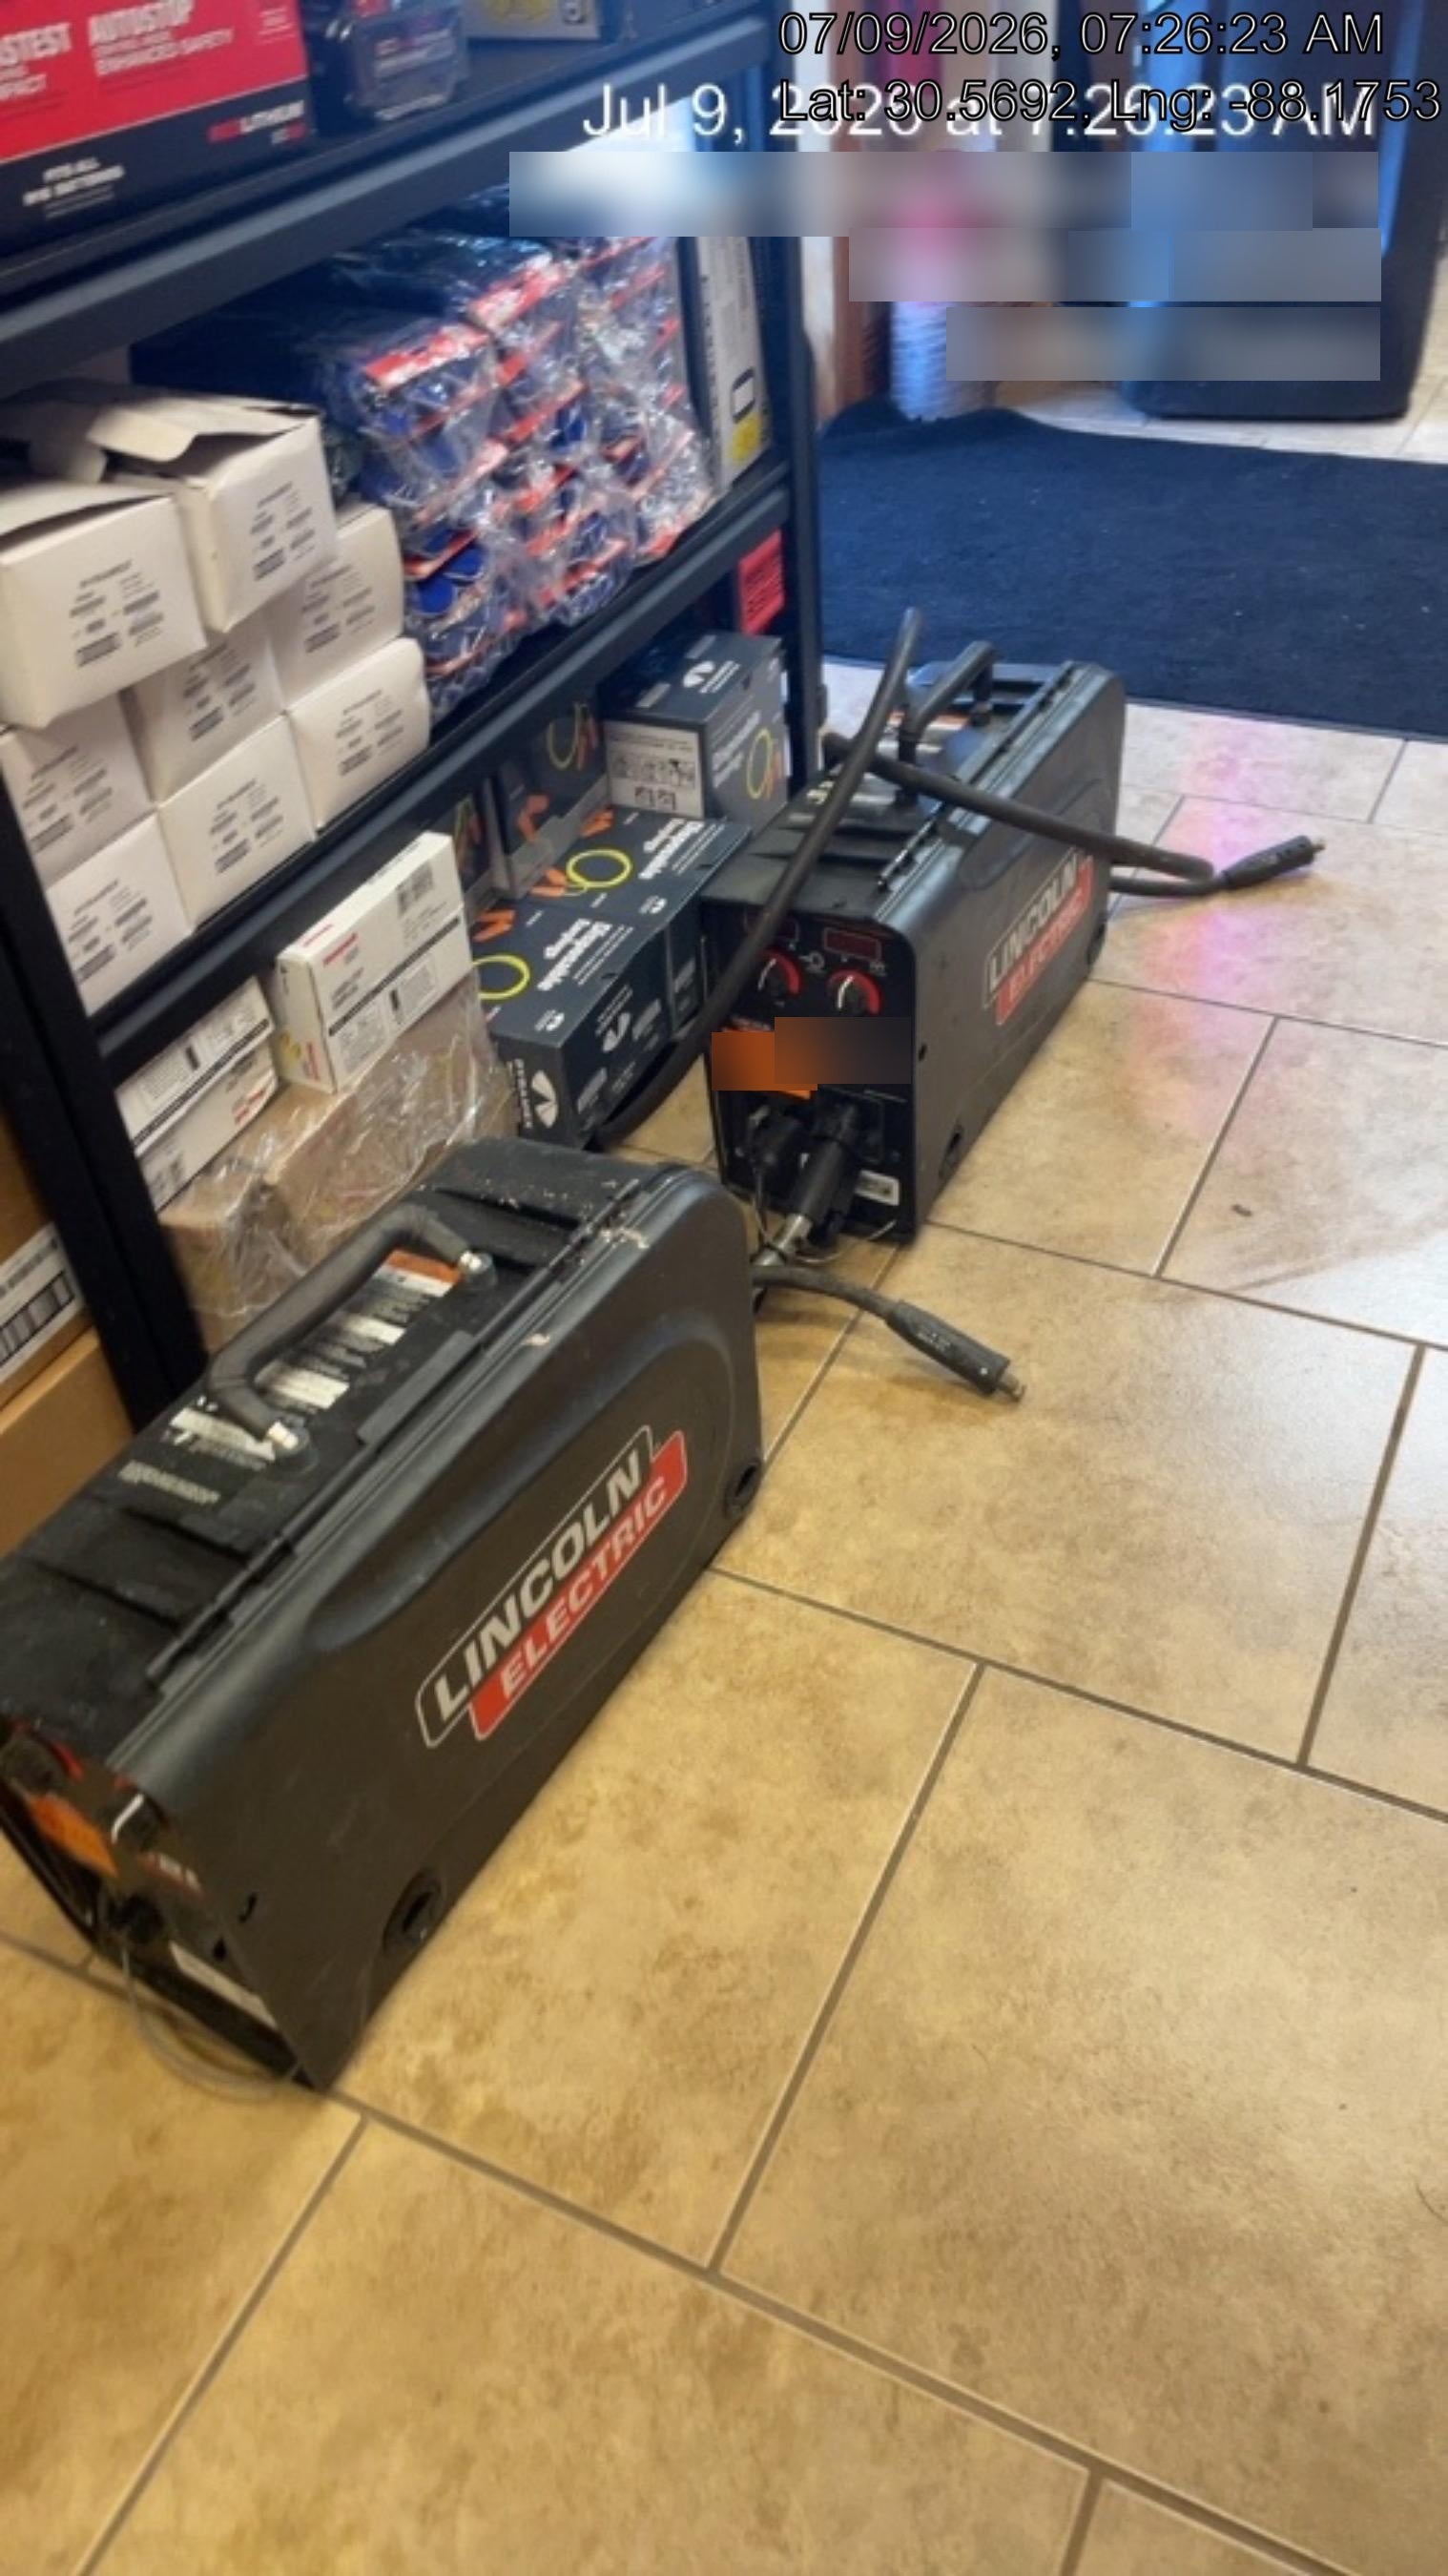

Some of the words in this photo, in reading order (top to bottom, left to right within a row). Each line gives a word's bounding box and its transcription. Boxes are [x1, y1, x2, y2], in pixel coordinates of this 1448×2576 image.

[989, 852, 1078, 993] LINCOLN
[433, 1449, 640, 1722] LINCOLN
[499, 1476, 668, 1699] ELECTRIC
